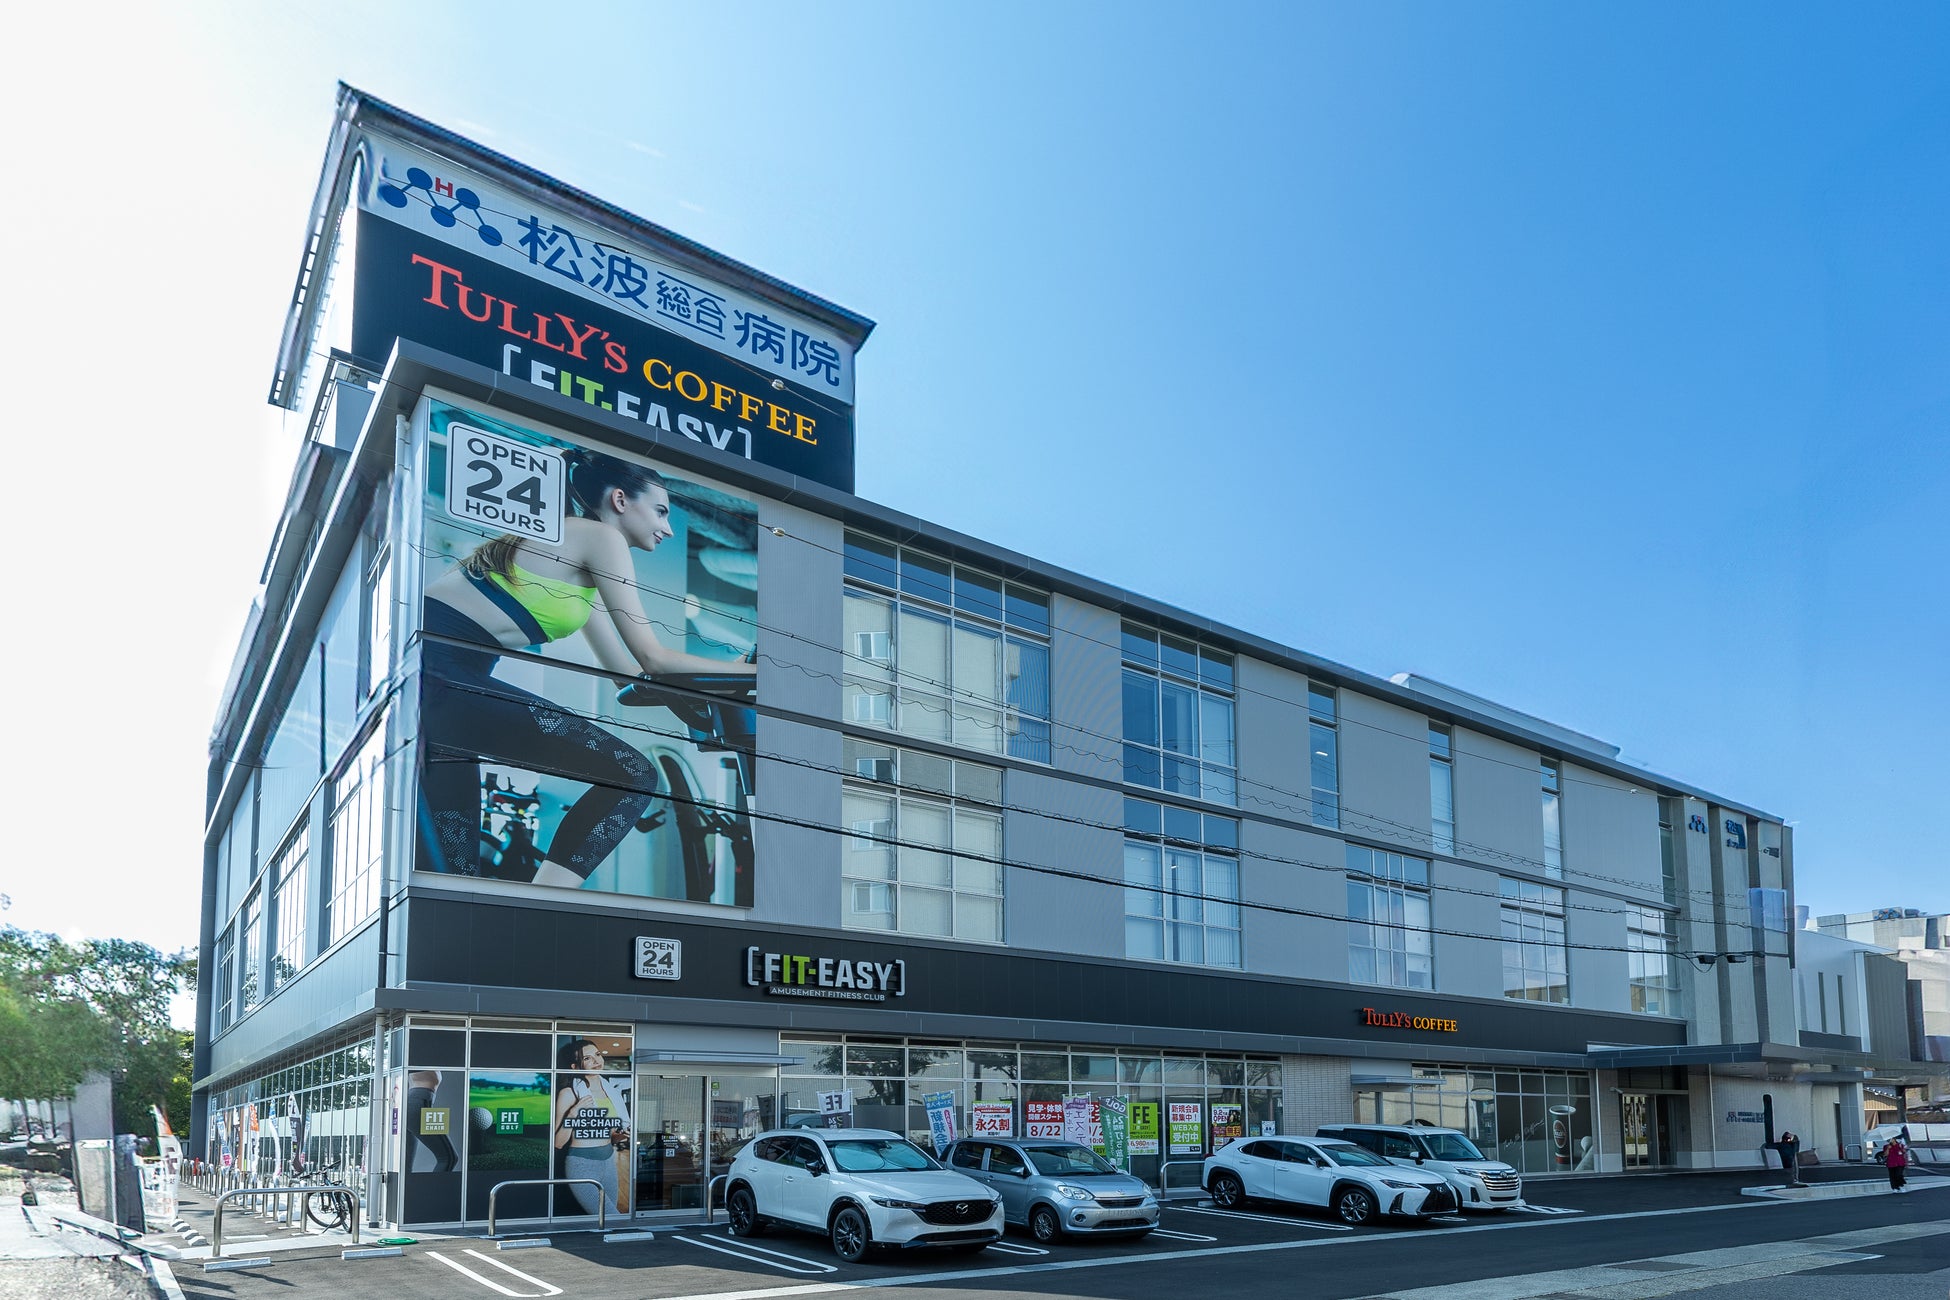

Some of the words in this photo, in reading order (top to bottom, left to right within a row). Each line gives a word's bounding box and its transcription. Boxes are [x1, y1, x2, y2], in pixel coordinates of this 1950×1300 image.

[516, 216, 840, 388] 松波総合病院
[411, 253, 628, 374] TULLY'S
[643, 359, 817, 446] COFFEE
[467, 438, 548, 476] OPEN
[466, 459, 546, 516] 24
[465, 499, 546, 533] HOURS
[642, 941, 675, 951] OPEN
[642, 950, 674, 969] 24
[642, 967, 674, 976] HOURS
[770, 987, 827, 998] AMUSEMENT
[828, 991, 862, 1000] FITNESS
[863, 993, 885, 1001] CLUB
[1363, 1007, 1411, 1028] TULLY'S
[1413, 1016, 1458, 1032] COFFEE
[425, 1111, 445, 1123] FIT
[501, 1111, 519, 1123] FIT
[579, 1109, 607, 1118] GOLF
[564, 1119, 621, 1128] EMS-CHAIR
[975, 1118, 1010, 1131] 永久割
[575, 1127, 610, 1139] ESTHÉ
[1030, 1125, 1061, 1136] 8/22
[1172, 1132, 1199, 1142] 受付中
